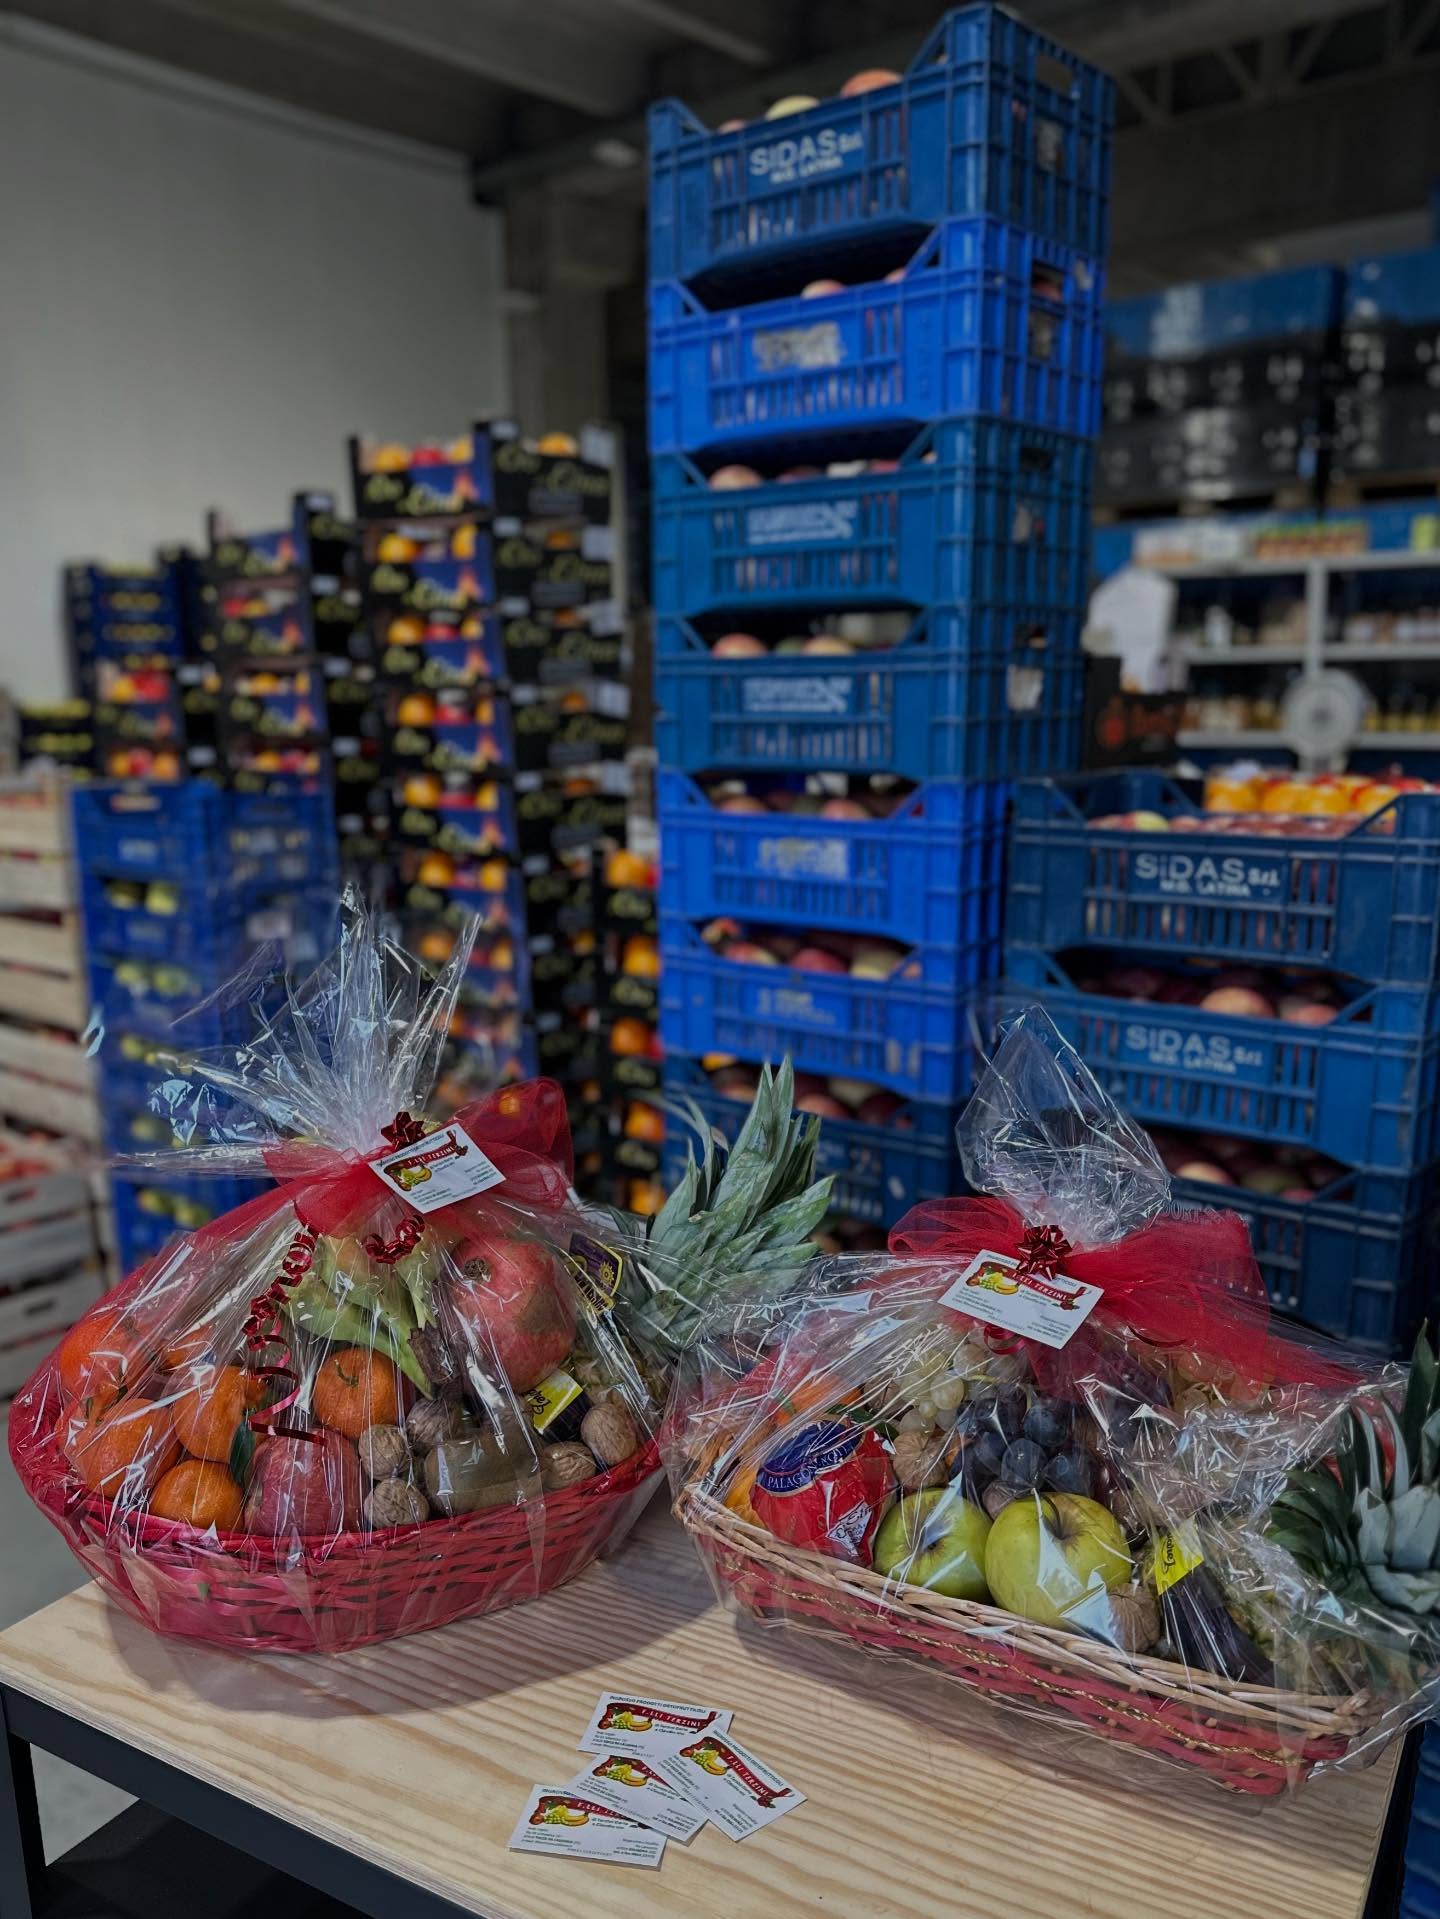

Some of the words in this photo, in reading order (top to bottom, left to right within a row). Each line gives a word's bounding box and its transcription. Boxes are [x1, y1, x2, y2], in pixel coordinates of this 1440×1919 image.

[751, 129, 836, 175] SIDAS
[1135, 853, 1245, 883] SIDAS
[1125, 1025, 1231, 1063] SIDAS
[1034, 1282, 1067, 1300] TERZINI
[641, 1708, 664, 1719] F.LLI
[666, 1714, 701, 1728] TERZINI
[726, 1755, 743, 1771] F.LLI
[743, 1772, 769, 1796] TERZINI
[577, 1802, 600, 1812] F.LLI
